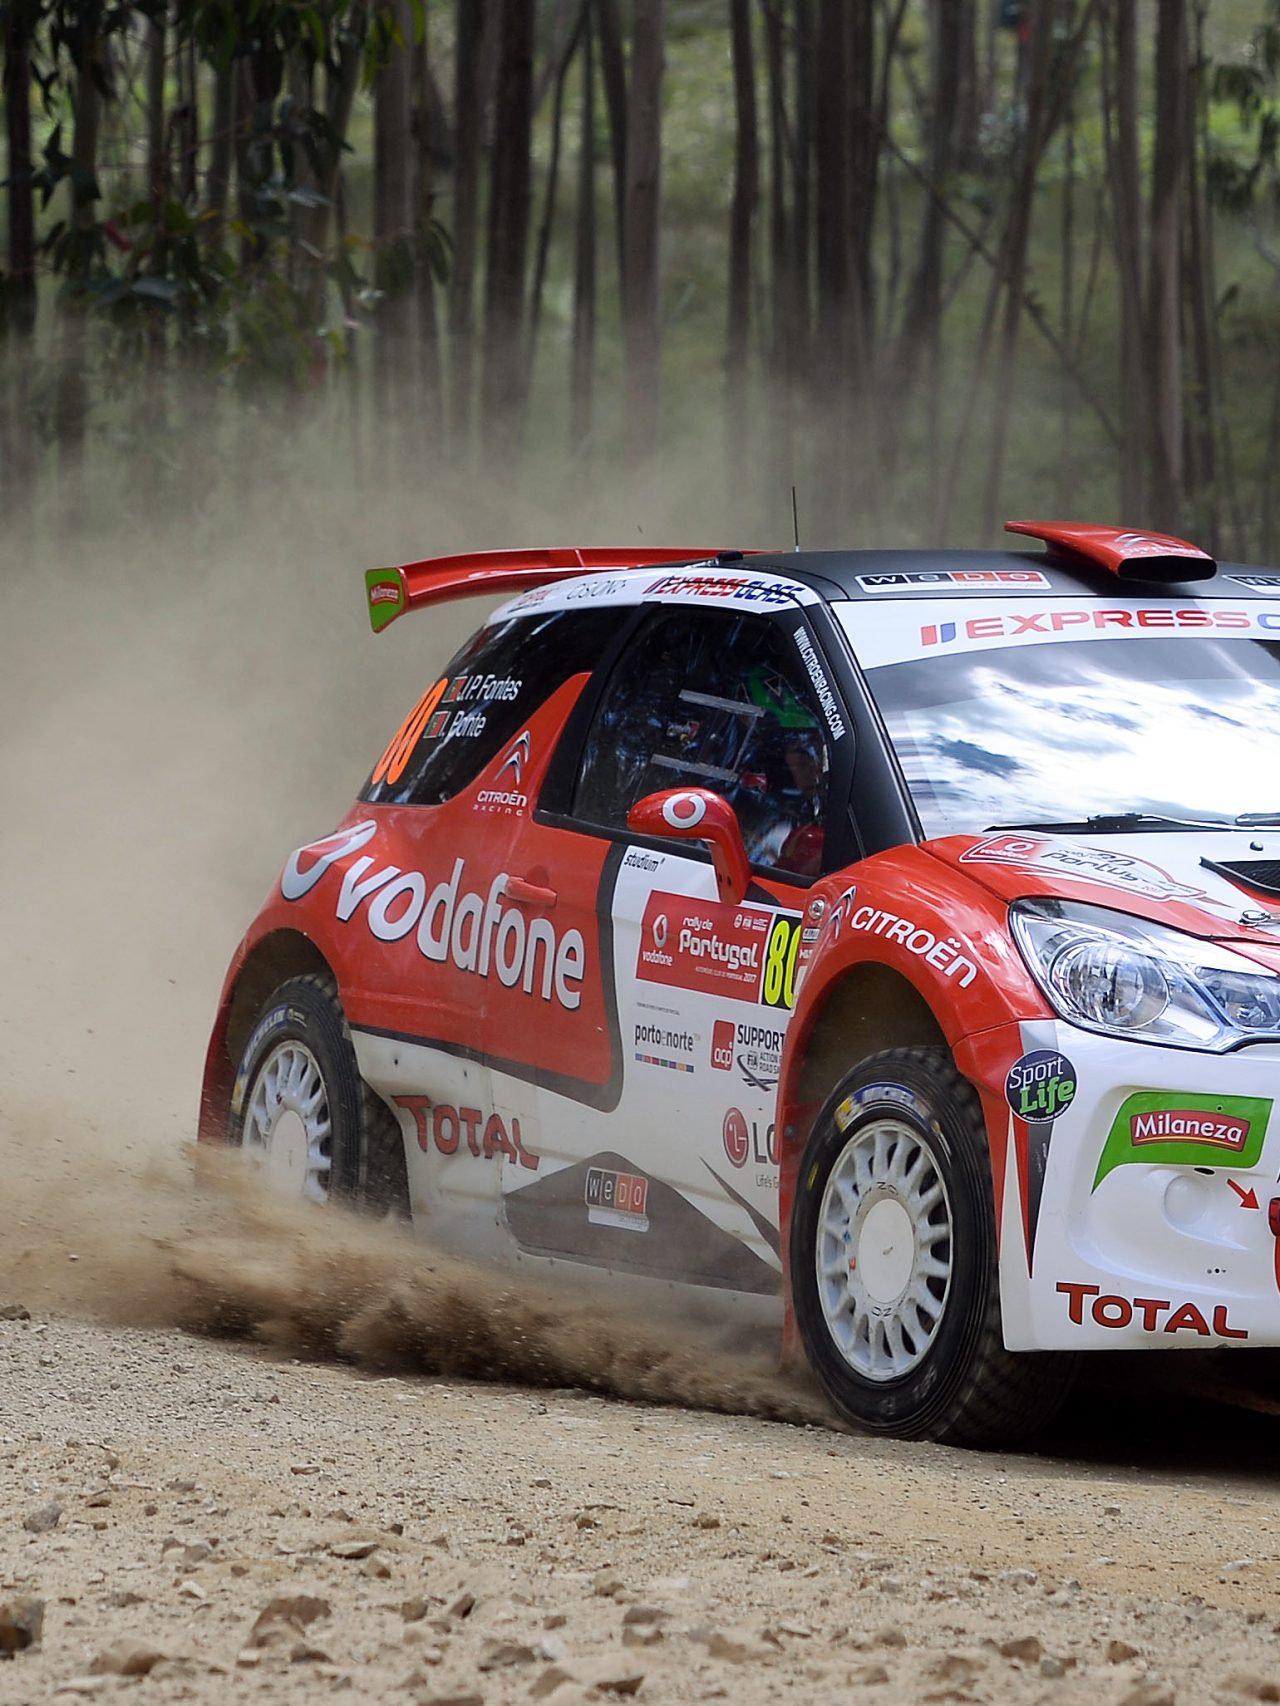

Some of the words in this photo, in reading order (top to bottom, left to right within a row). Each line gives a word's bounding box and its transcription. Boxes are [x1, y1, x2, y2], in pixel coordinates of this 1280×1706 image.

[476, 674, 522, 701] Fontes
[336, 856, 585, 1010] vodafone
[701, 919, 714, 931] de
[642, 950, 673, 967] vodafone
[679, 929, 758, 970] Portugal
[1009, 1056, 1064, 1089] Sport
[1020, 1076, 1074, 1114] Life
[391, 1095, 540, 1171] TOTAL
[1135, 1113, 1242, 1143] Milaneza
[1056, 1282, 1248, 1339] TOTAL
